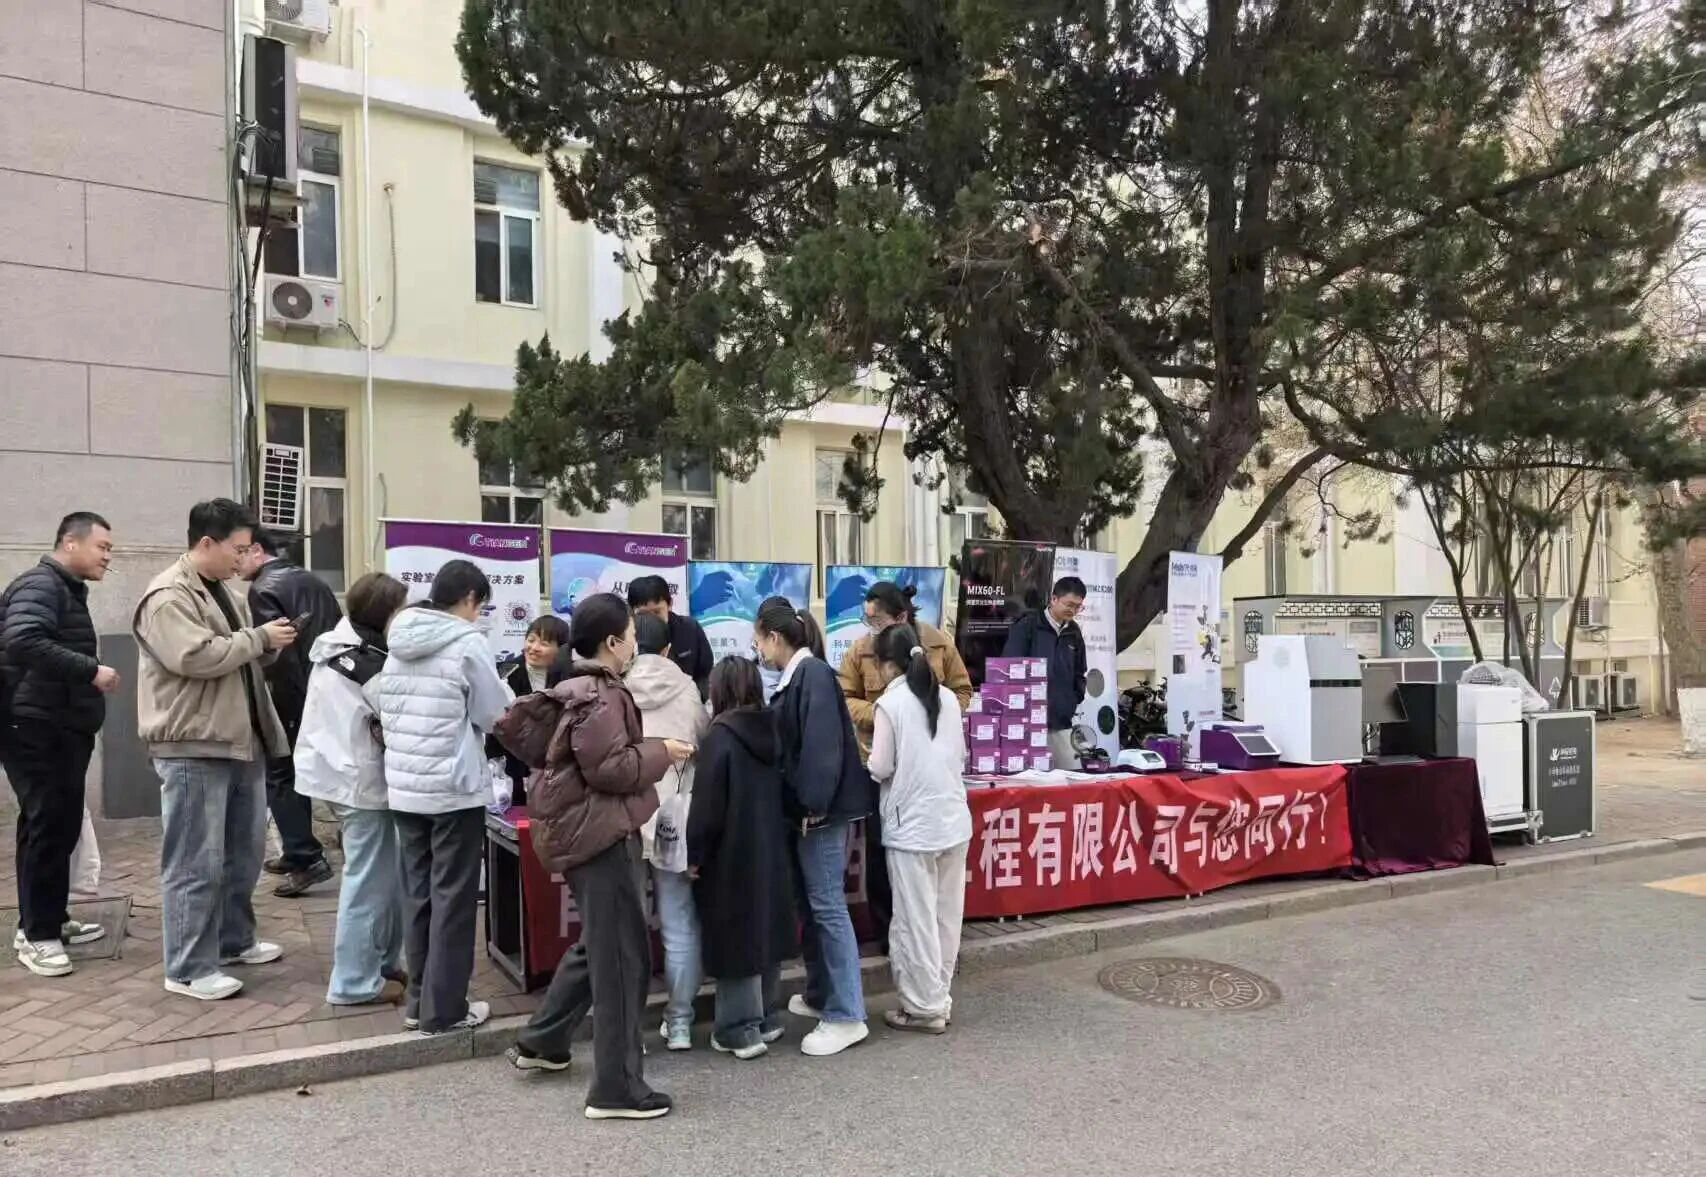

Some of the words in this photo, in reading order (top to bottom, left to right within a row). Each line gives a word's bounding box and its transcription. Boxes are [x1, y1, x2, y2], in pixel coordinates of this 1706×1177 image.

[967, 585, 1005, 596] MIX60-FL
[966, 788, 1328, 890] 程有限公司与您同行！
